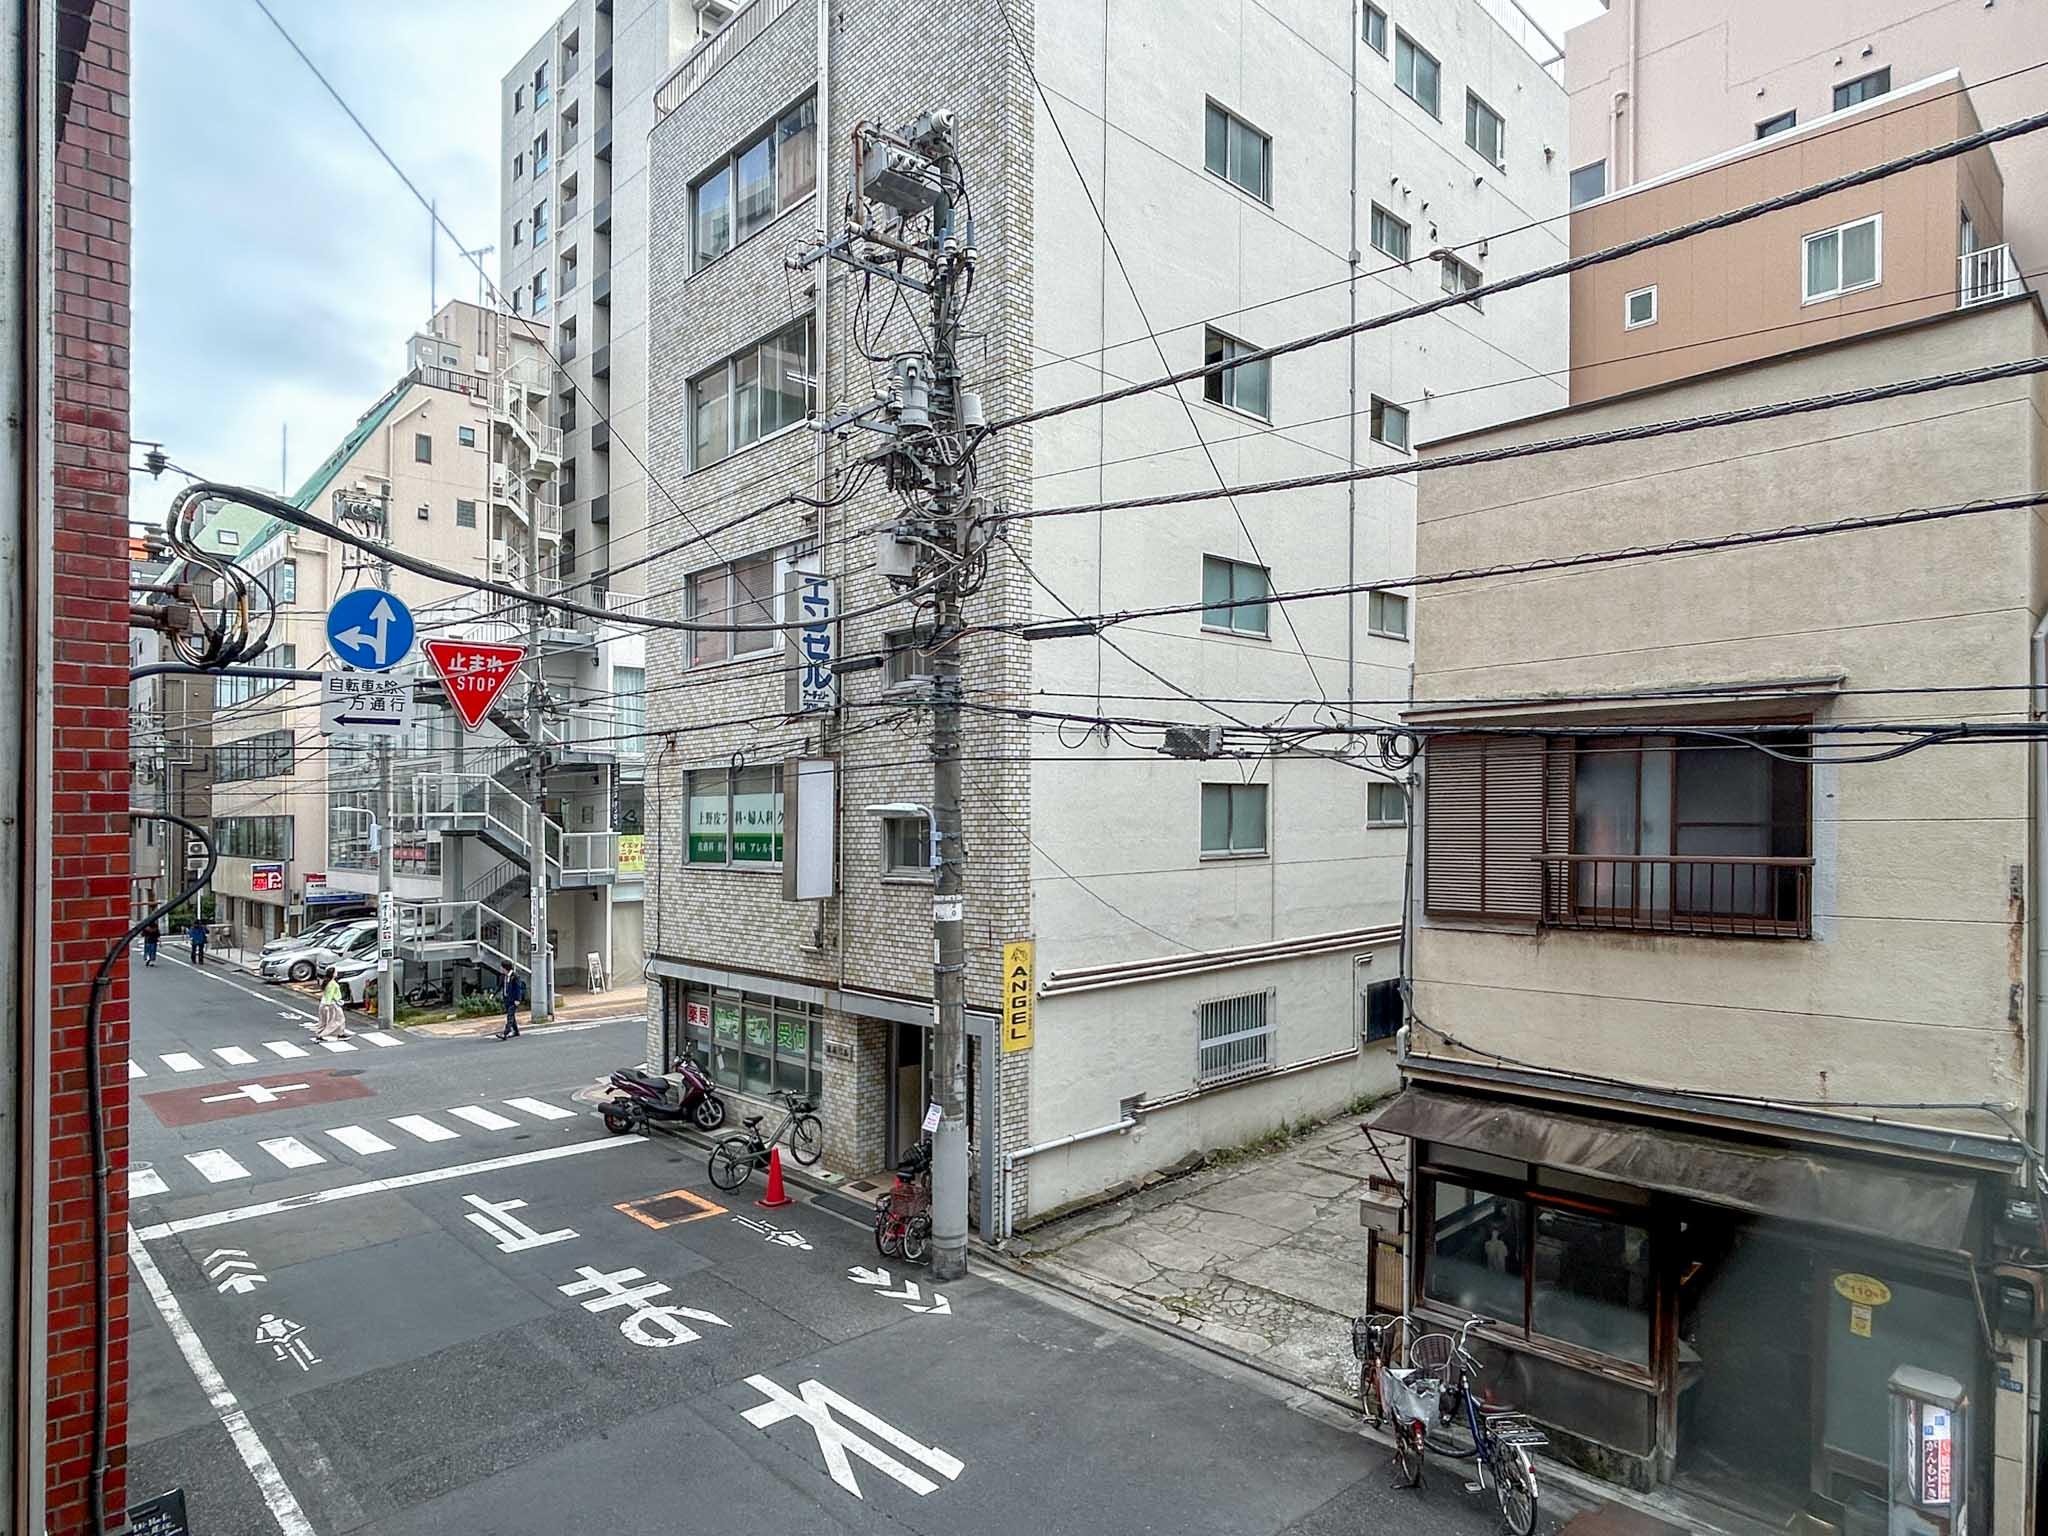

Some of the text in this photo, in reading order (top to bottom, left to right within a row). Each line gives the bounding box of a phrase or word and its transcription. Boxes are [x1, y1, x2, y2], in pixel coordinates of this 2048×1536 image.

[448, 652, 505, 673] 止まれ
[329, 677, 406, 695] 自転車を除く
[457, 676, 496, 692] STOP
[1011, 966, 1027, 1040] ANGEL
